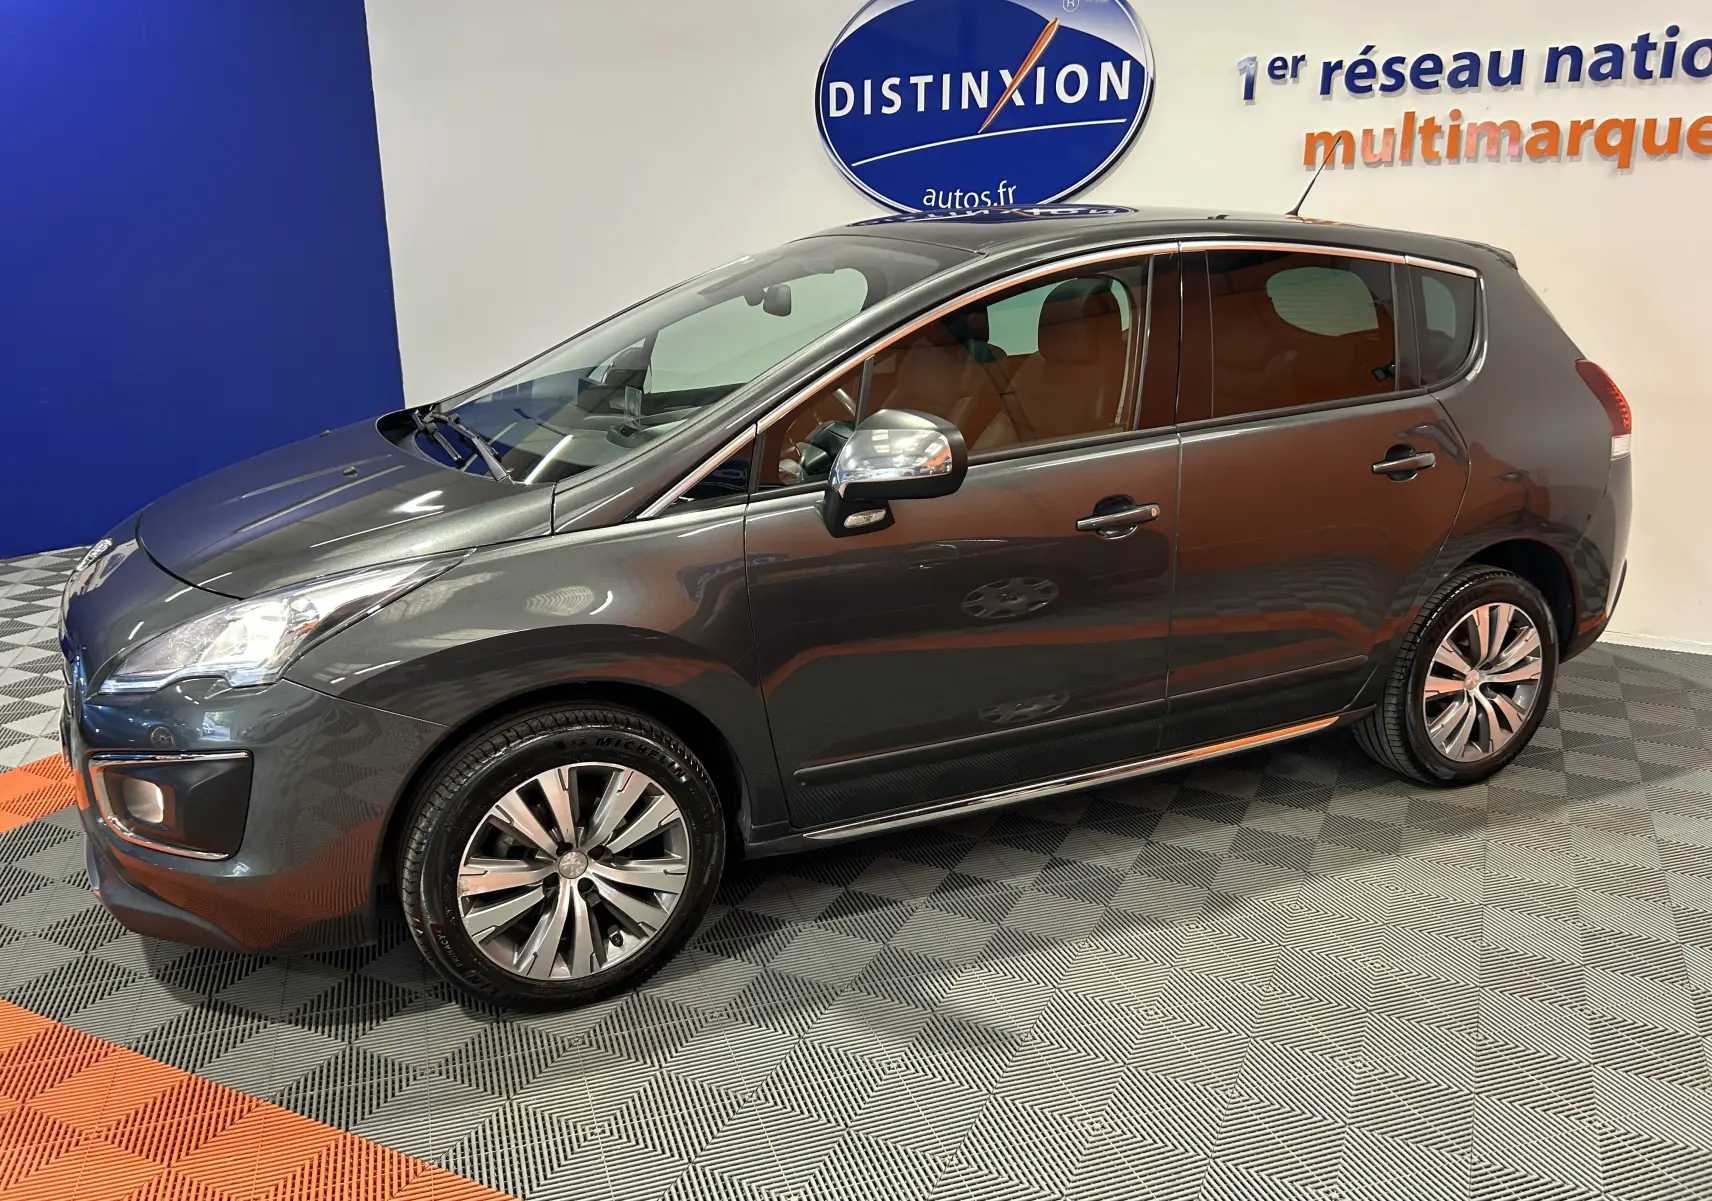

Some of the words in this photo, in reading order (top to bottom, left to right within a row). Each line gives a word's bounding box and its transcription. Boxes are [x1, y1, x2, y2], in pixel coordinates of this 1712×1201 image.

[1236, 53, 1306, 101] 1er
[1319, 44, 1526, 96] réseau
[1544, 24, 1712, 84] natio
[828, 59, 1132, 133] DISTINXION
[1302, 107, 1712, 169] multimarque
[922, 179, 1017, 209] autos.fr
[595, 737, 688, 784] MICHELIN
